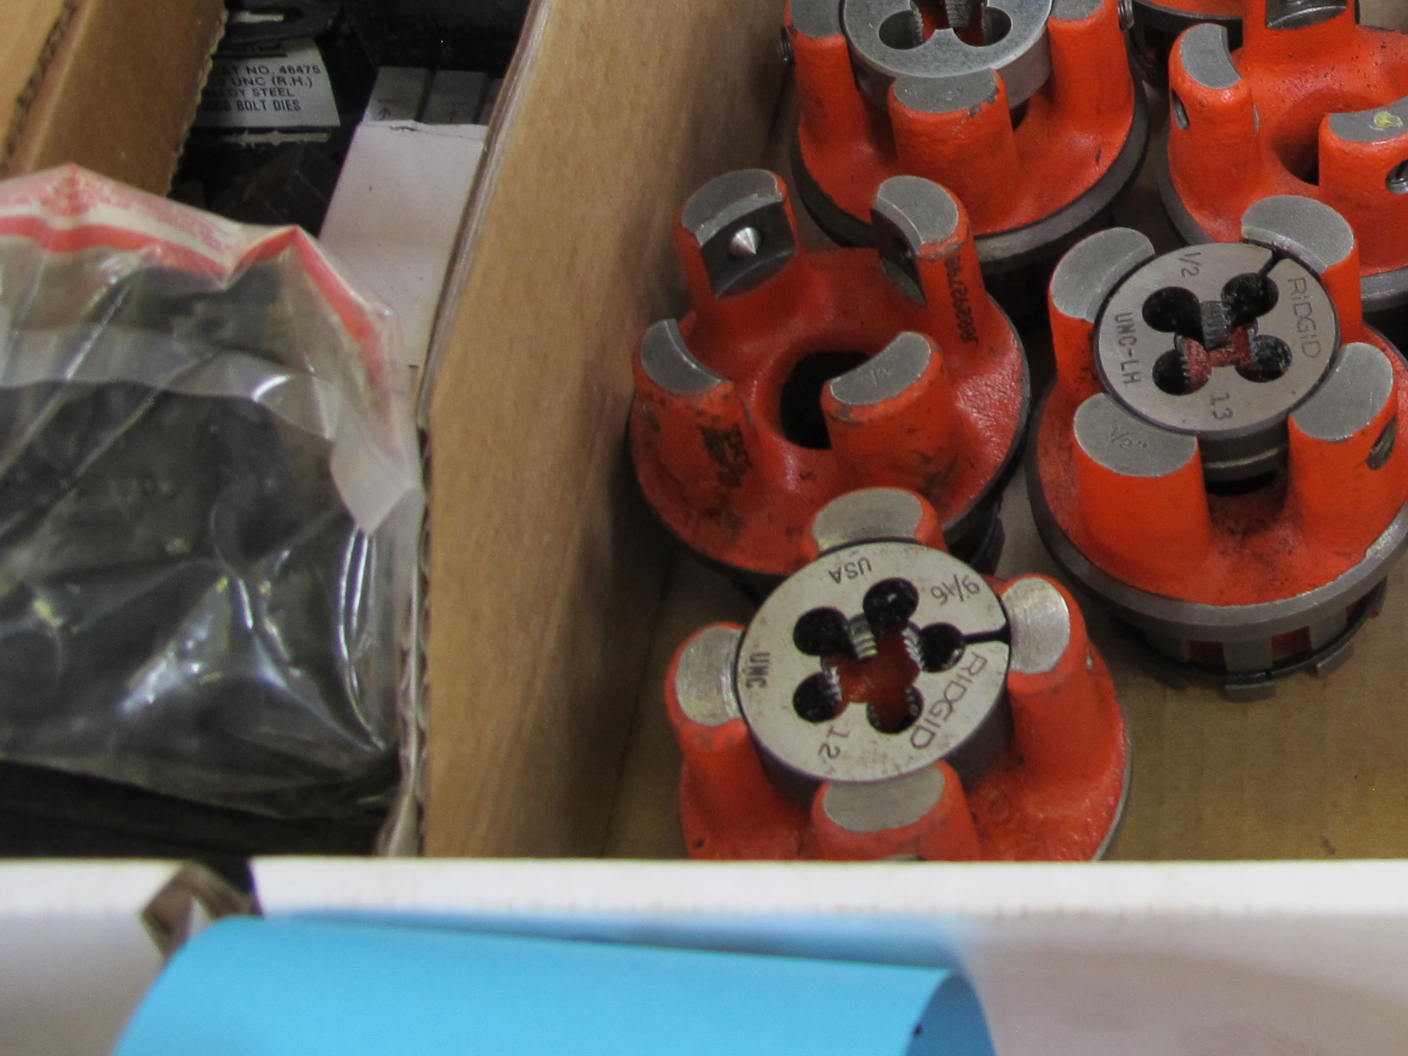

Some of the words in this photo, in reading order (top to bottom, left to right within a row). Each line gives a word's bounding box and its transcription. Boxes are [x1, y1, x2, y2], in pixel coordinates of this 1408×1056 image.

[231, 76, 266, 87] UNC
[253, 88, 295, 97] STEEL
[236, 99, 267, 112] BOLT
[273, 99, 302, 112] DIES
[1177, 252, 1203, 279] 1/2
[1287, 277, 1322, 360] RIDGID
[1114, 312, 1142, 386] UNC-LH
[1208, 393, 1234, 421] 13
[828, 556, 872, 585] USA
[930, 572, 981, 606] 9/16
[745, 651, 770, 689] UNC
[910, 651, 988, 749] RIDGID
[818, 724, 850, 759] 12
